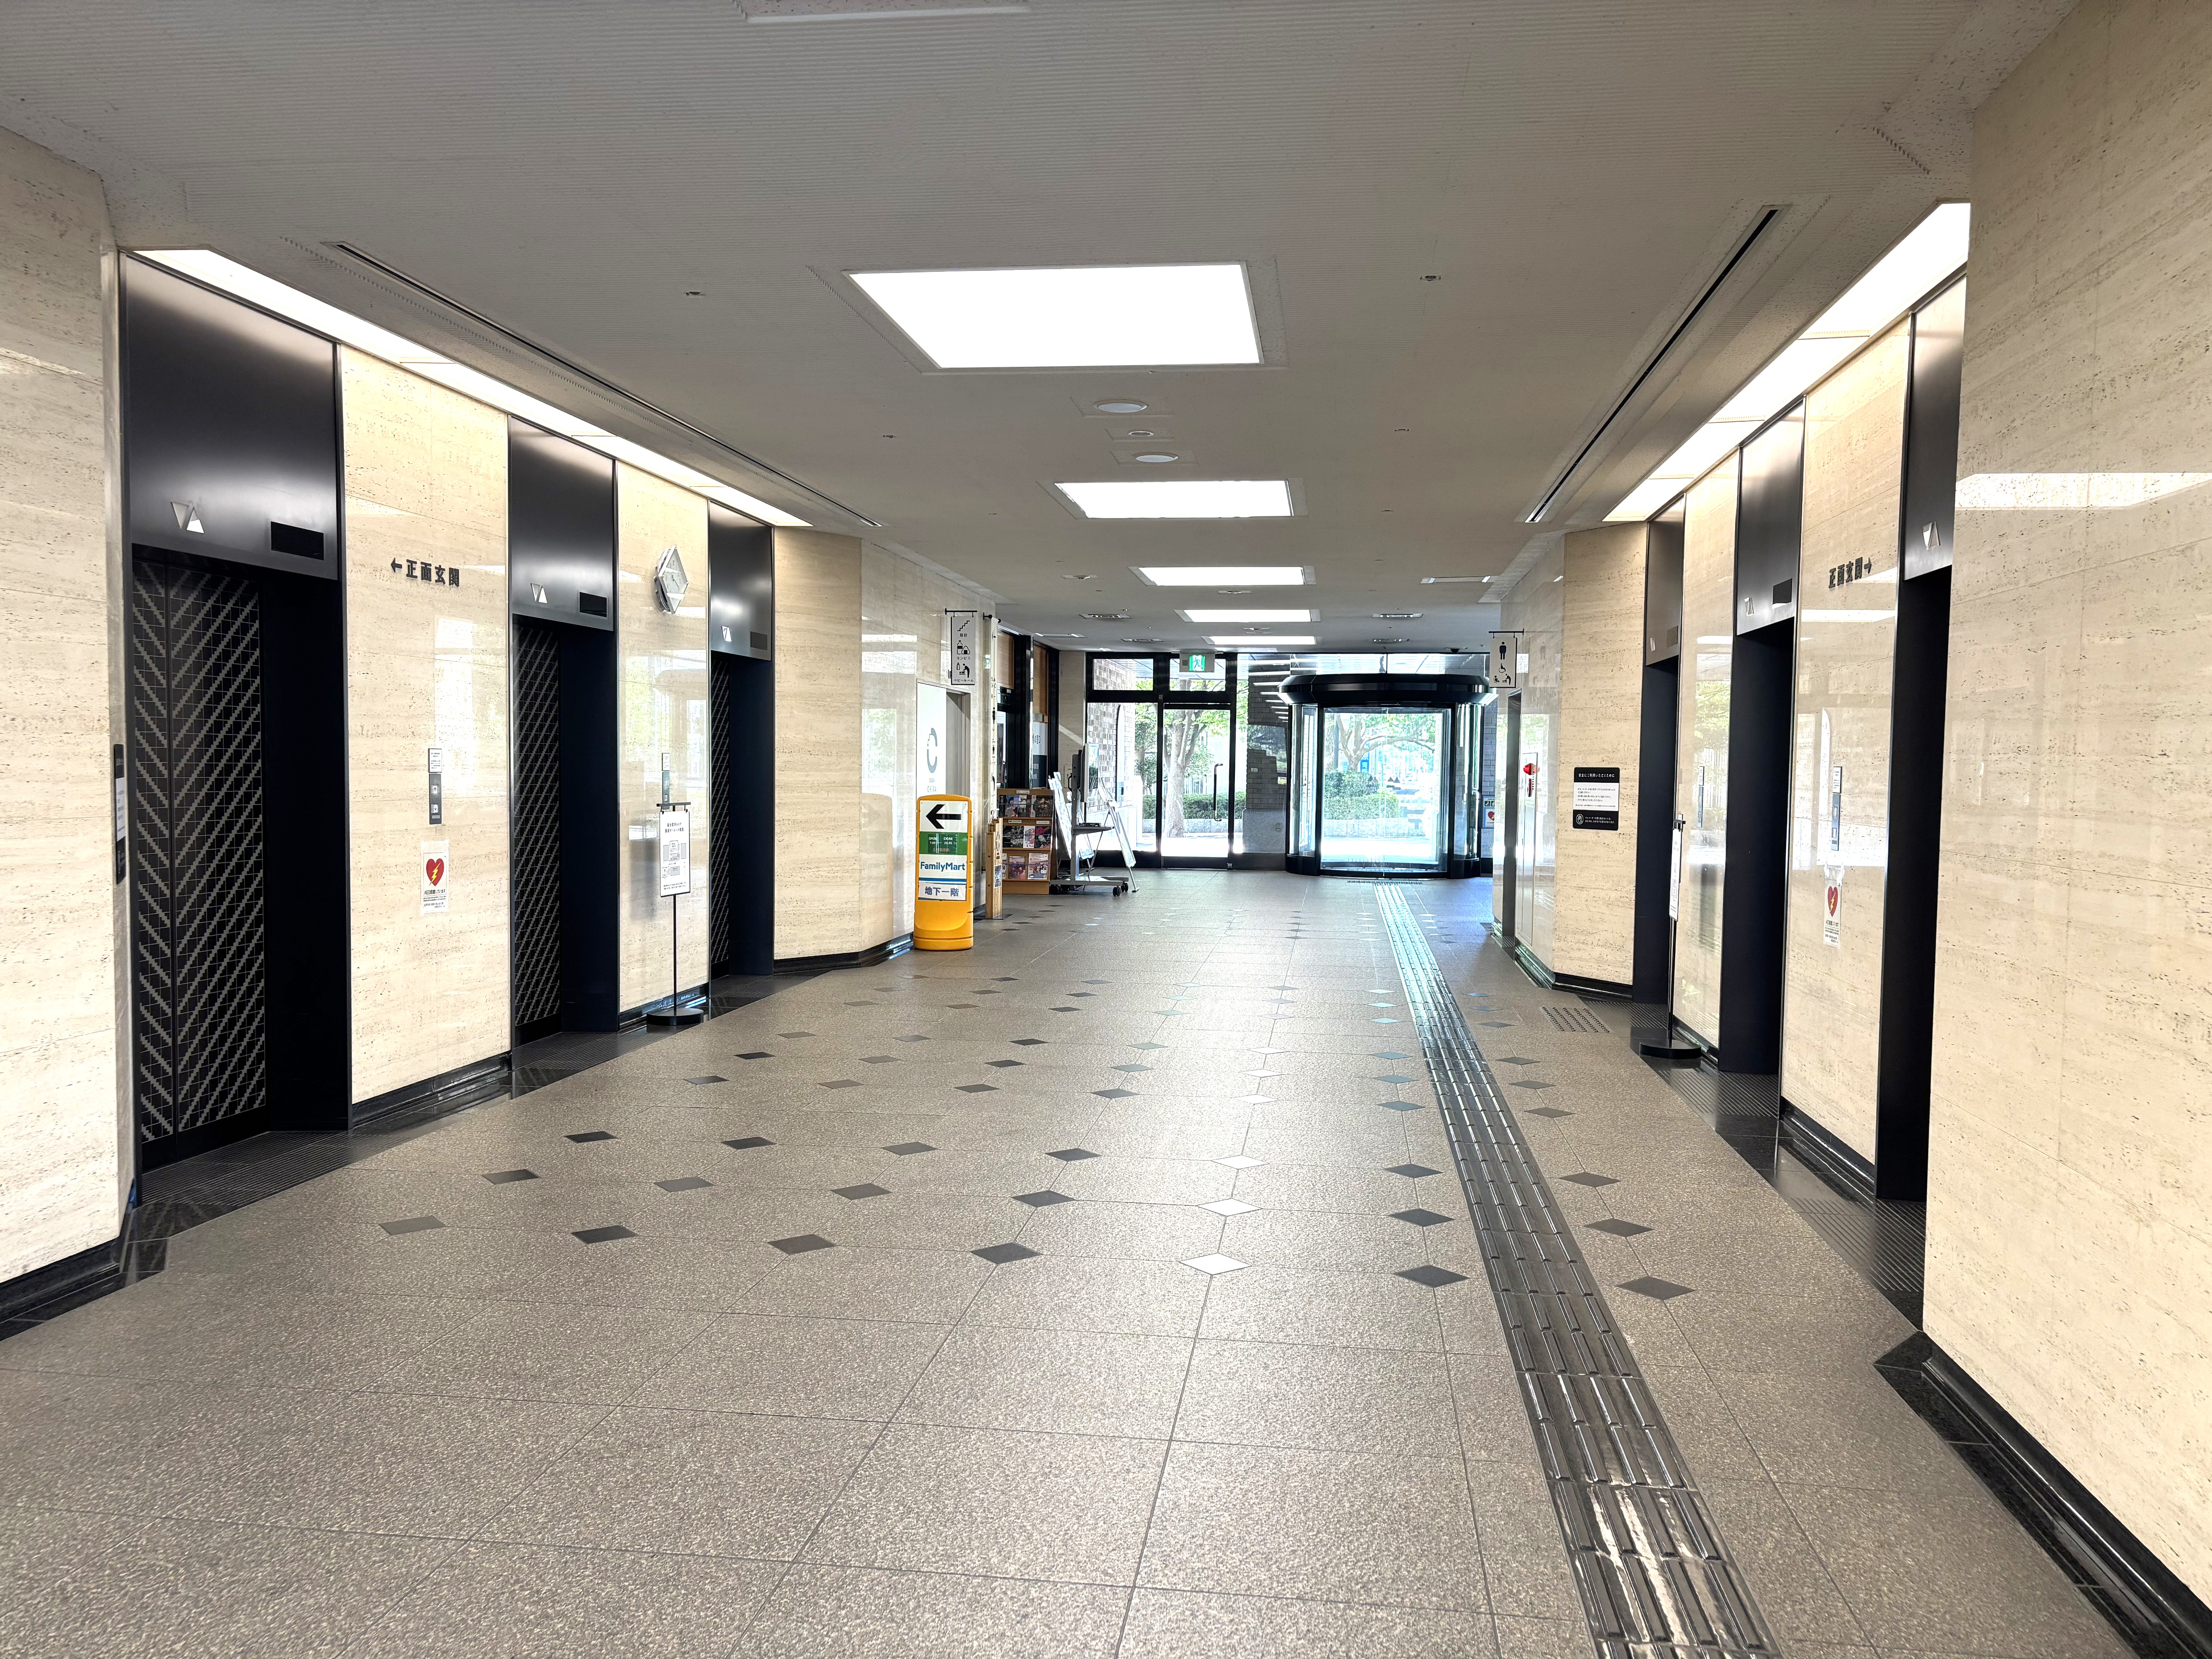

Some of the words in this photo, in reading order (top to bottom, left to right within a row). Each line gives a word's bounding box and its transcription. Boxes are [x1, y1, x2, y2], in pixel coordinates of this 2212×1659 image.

[406, 559, 460, 587] 正面玄関
[1829, 556, 1863, 589] 正面玄関
[920, 862, 965, 872] FamilyMart
[924, 886, 959, 897] 地下一階
